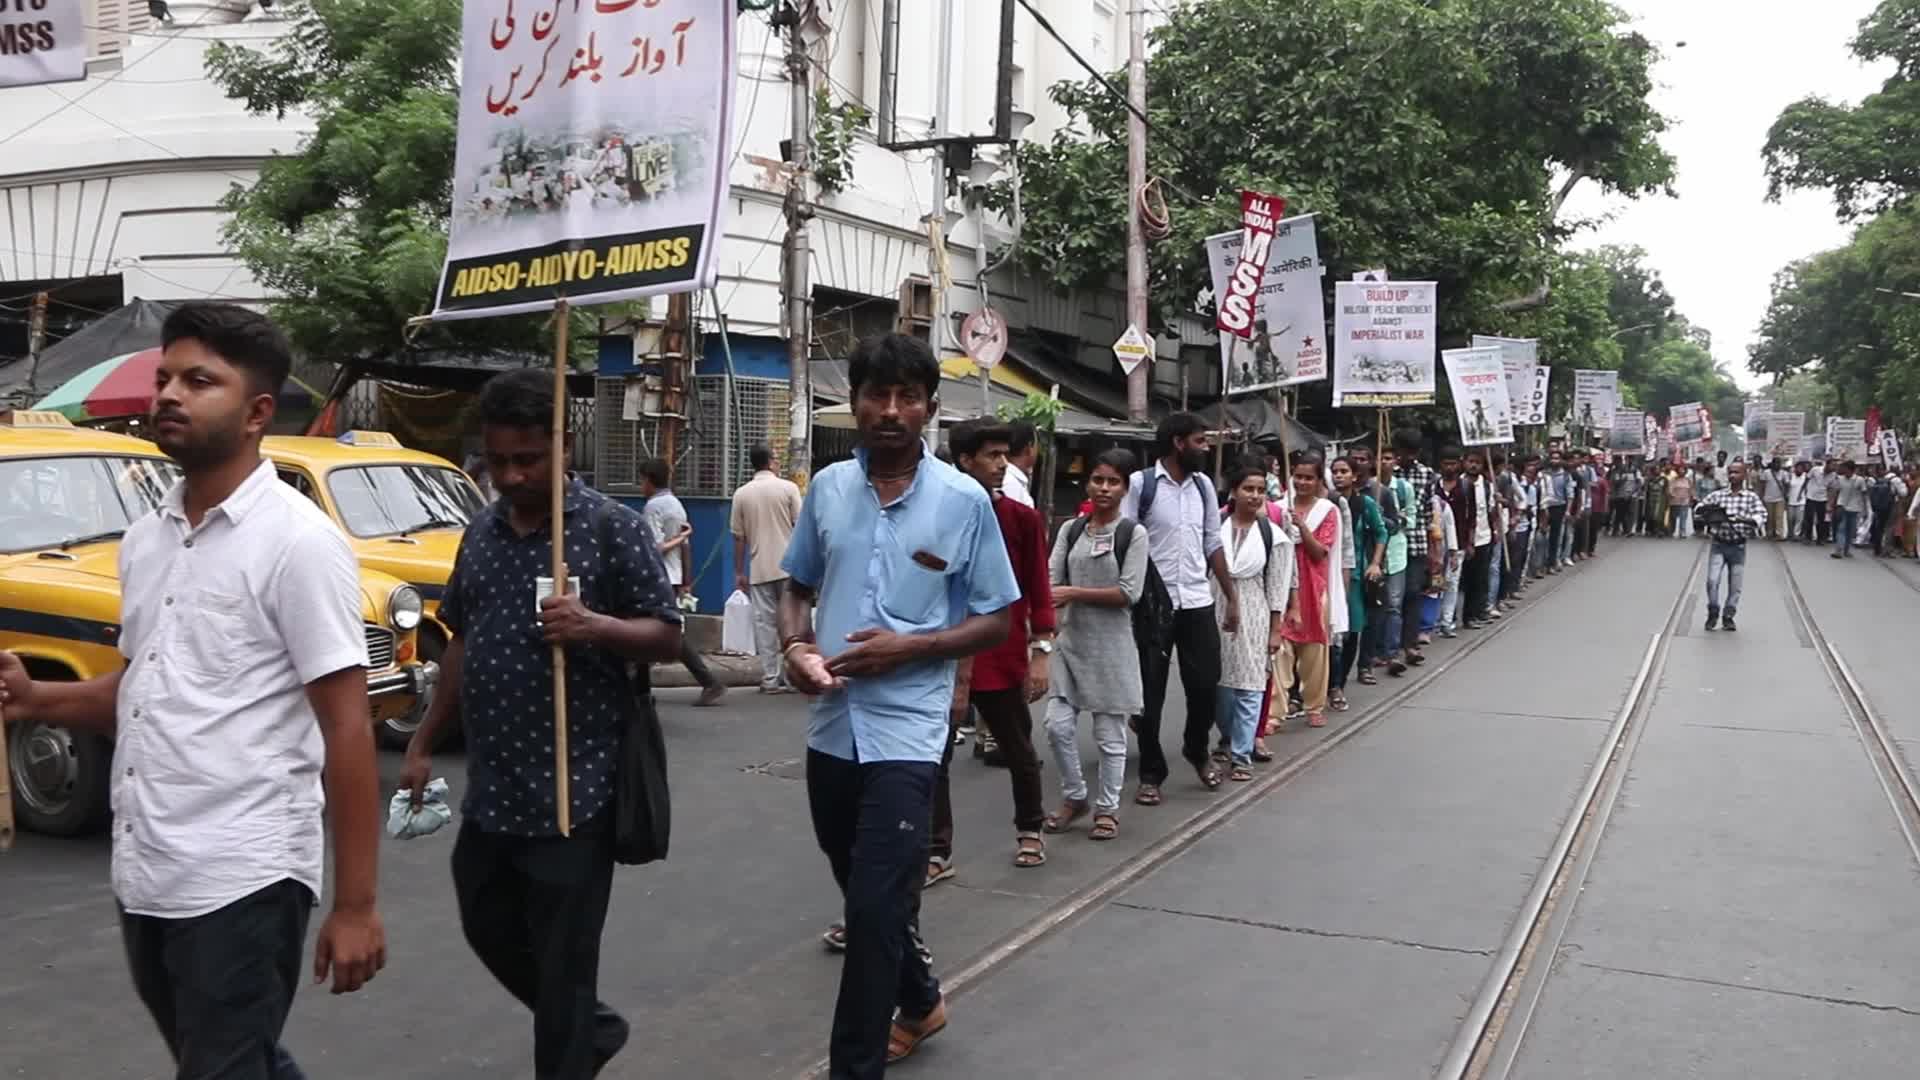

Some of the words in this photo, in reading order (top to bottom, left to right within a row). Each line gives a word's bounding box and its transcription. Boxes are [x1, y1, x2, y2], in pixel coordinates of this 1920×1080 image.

[486, 34, 560, 116] کریں
[559, 31, 603, 88] بلند
[620, 17, 697, 77] آواز
[1244, 211, 1273, 231] INDIA
[1248, 199, 1272, 216] ALL
[451, 236, 691, 298] AIDSO-AIDYO-AIMSS
[1366, 289, 1394, 302] BUILD
[1396, 289, 1409, 302] UP
[1351, 328, 1402, 340] IMPERIALIST
[1405, 328, 1425, 340] WAR
[1528, 367, 1547, 423] AIDYO
